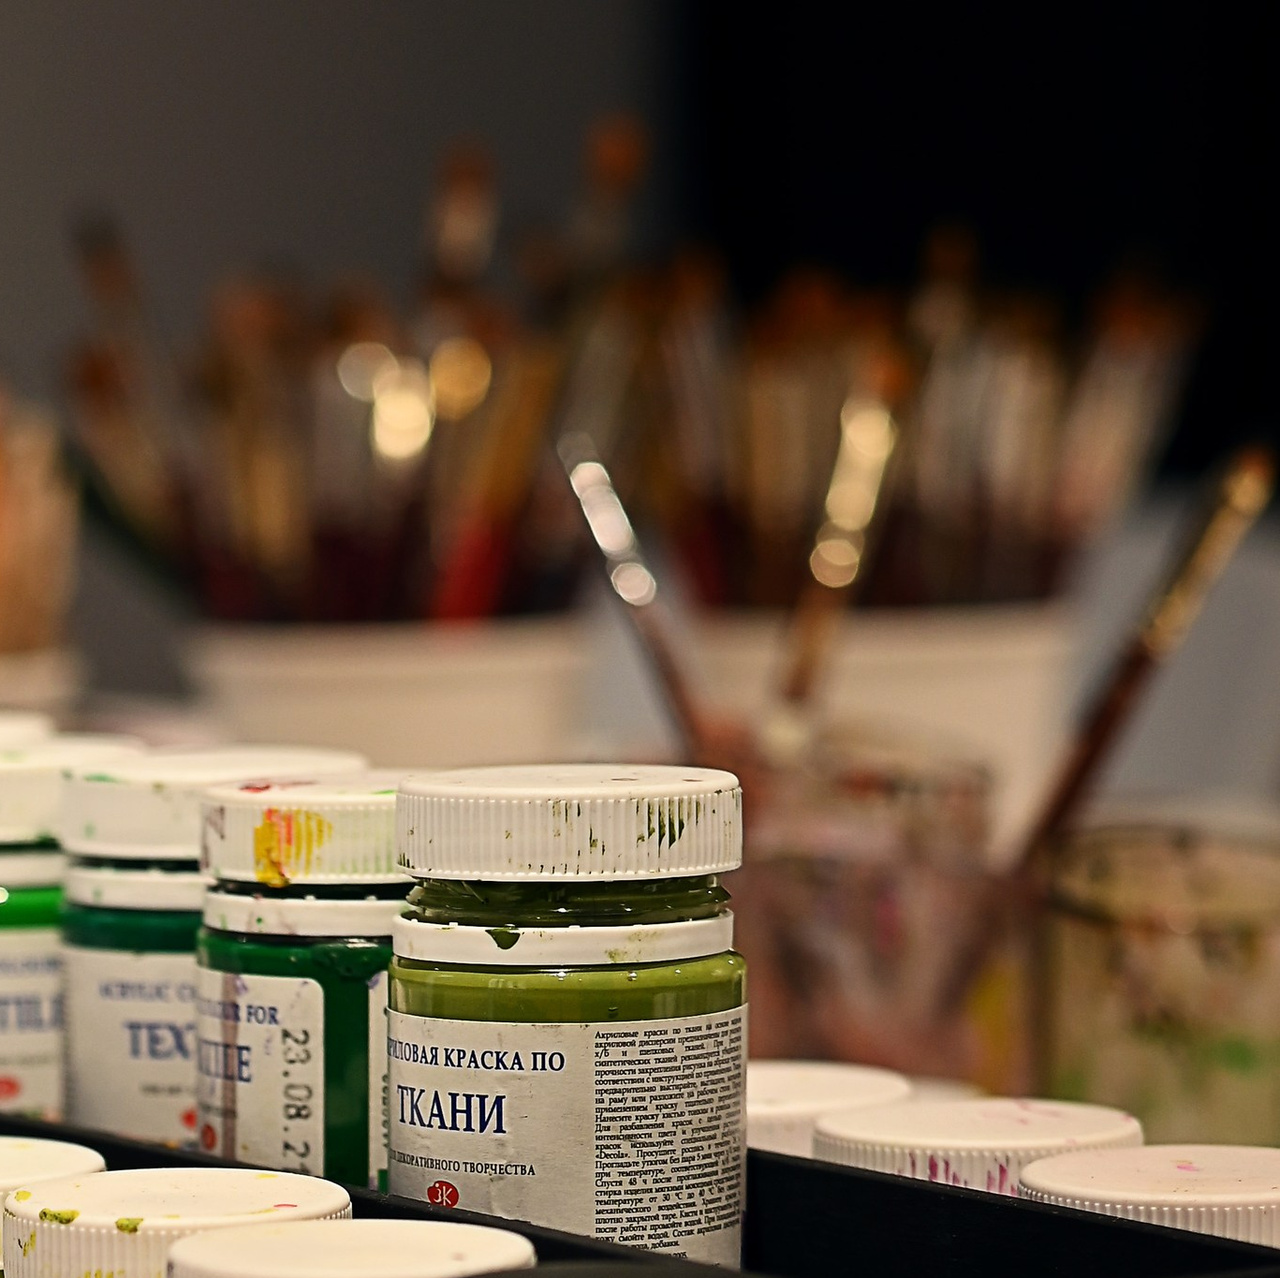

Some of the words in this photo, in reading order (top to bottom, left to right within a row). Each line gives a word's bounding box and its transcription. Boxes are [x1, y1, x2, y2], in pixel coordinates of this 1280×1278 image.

[246, 1005, 279, 1025] FOR
[595, 1031, 638, 1039] Акриловые
[644, 1029, 668, 1038] краски
[595, 1041, 636, 1049] акриловой
[639, 1038, 675, 1047] дисперсии
[444, 1047, 524, 1071] КРАСКА
[531, 1052, 565, 1071] ПО
[595, 1058, 650, 1066] синтетических
[595, 1068, 636, 1078] прочности
[595, 1077, 644, 1085] соответствии
[595, 1086, 656, 1095] предварительно
[609, 1095, 628, 1106] раму
[397, 1085, 506, 1134] ТКАНИ
[655, 1103, 678, 1112] краску
[595, 1114, 632, 1123] Нанесите
[635, 1112, 659, 1123] краску
[595, 1124, 610, 1132] Для
[672, 1119, 692, 1128] красок
[637, 1148, 676, 1159] Просушите
[462, 1161, 536, 1175] ТВОРЧЕСТВА
[595, 1161, 639, 1170] Прогладьте
[642, 1159, 667, 1168] утюгом
[595, 1171, 611, 1179] при
[595, 1179, 622, 1188] Спустя
[595, 1198, 643, 1207] температуре
[595, 1206, 651, 1215] механического
[626, 1214, 659, 1223] закрытой
[595, 1226, 617, 1234] после
[620, 1223, 647, 1234] работы
[619, 1234, 644, 1242] смойте
